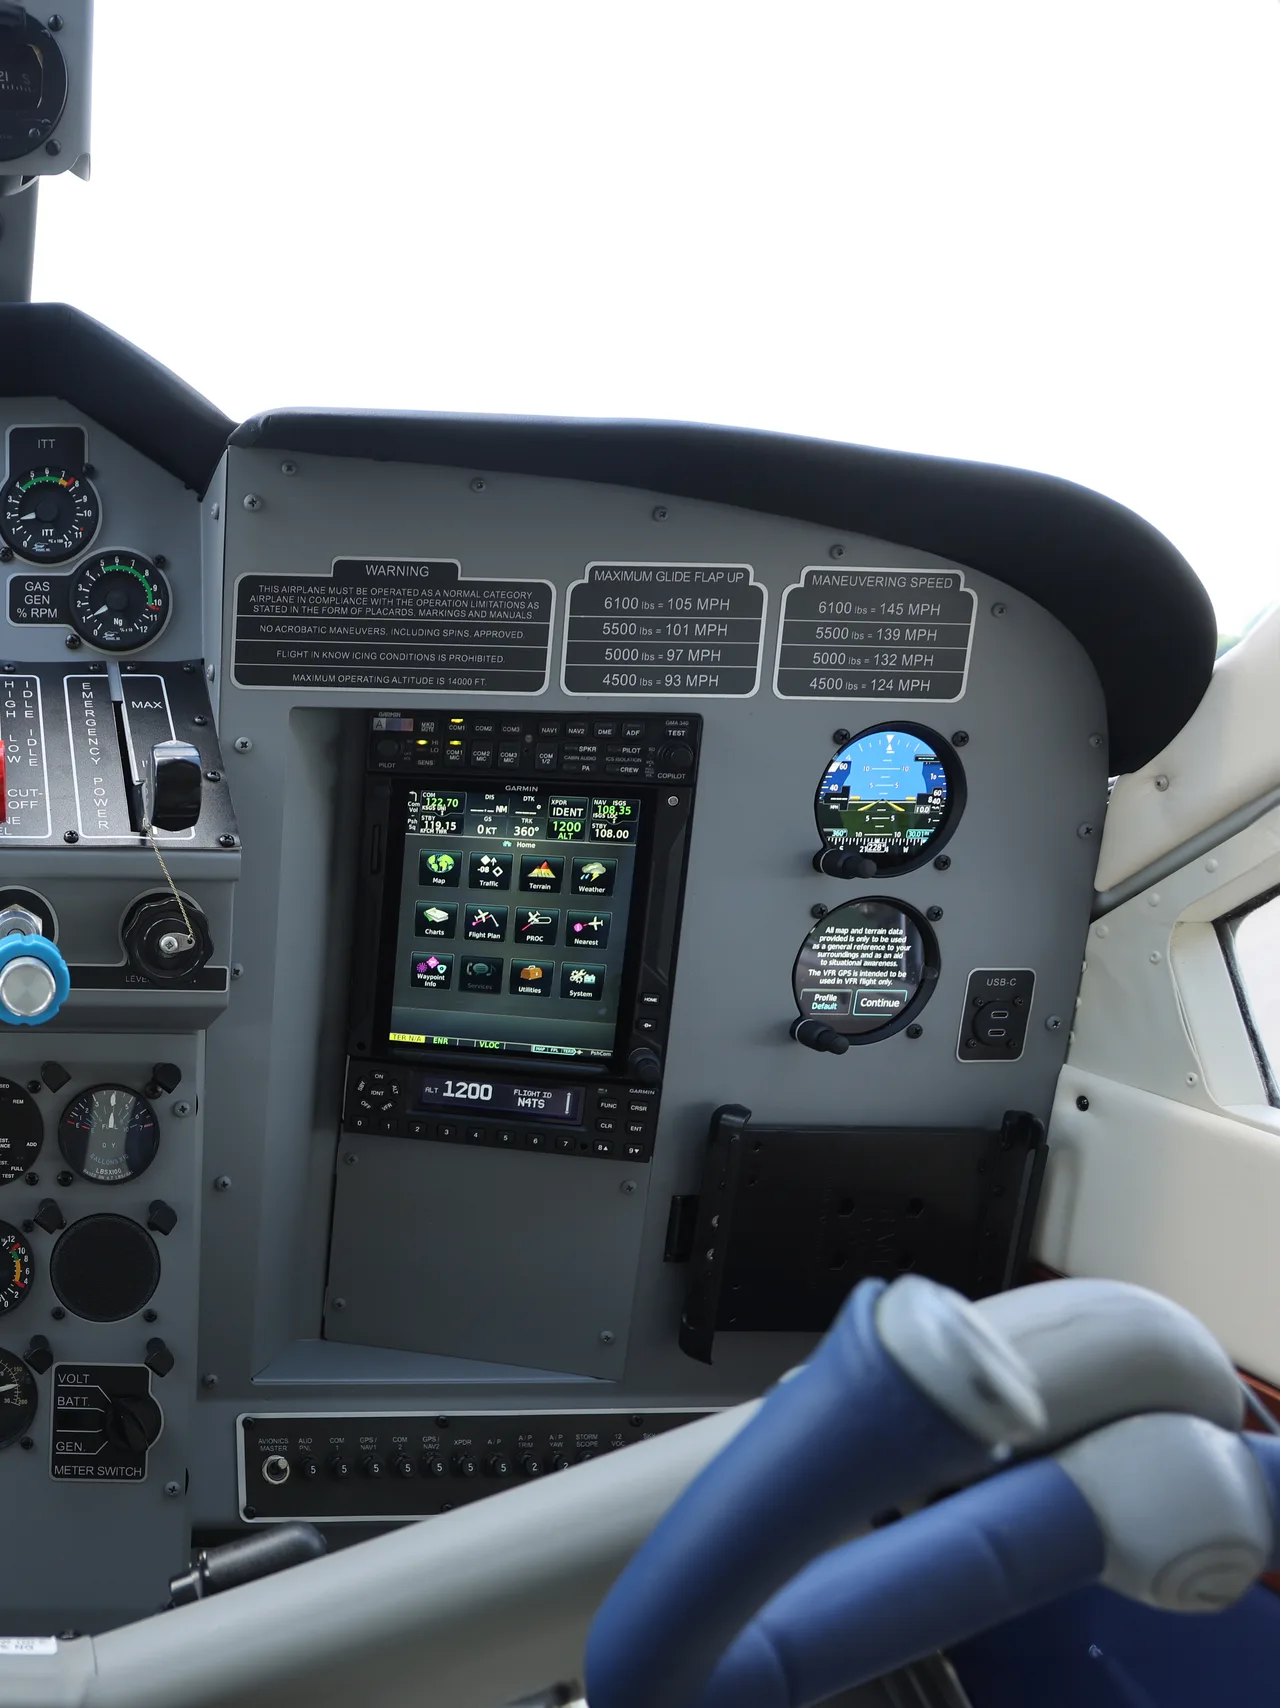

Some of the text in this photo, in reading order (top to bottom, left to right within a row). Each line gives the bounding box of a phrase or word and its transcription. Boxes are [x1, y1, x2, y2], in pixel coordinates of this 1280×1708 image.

[37, 439, 56, 448] ITT
[365, 565, 429, 577] WARNING
[594, 571, 744, 583] MAXIMUM GLIDE FLAP UP
[24, 581, 50, 591] GAS
[812, 576, 952, 589] MANEUVERING SPEED
[24, 595, 50, 604] GEN
[17, 608, 57, 618] % RPM
[818, 602, 852, 614] 6100
[854, 605, 868, 615] lbs
[880, 603, 904, 615] 145
[908, 604, 941, 616] MPH
[292, 674, 336, 682] MAXIMUM
[338, 675, 390, 684] OPERATING
[391, 676, 434, 684] ALTITUDE
[436, 677, 444, 685] IS
[448, 677, 472, 685] 14000
[82, 683, 109, 829] EMERGENCY POWER
[8, 789, 43, 797] CUT-
[8, 801, 38, 809] OFF
[425, 798, 458, 807] 122.70
[553, 808, 583, 817] IDENT
[552, 821, 581, 832] 1200
[595, 830, 629, 839] 108.00
[433, 877, 445, 885] Map
[425, 928, 444, 936] Charts
[574, 938, 599, 946] Nearest
[986, 978, 1016, 986] USB-C
[815, 993, 837, 1002] Profile
[812, 1002, 837, 1010] Default
[860, 998, 900, 1008] Continue
[443, 1080, 493, 1101] 1200
[514, 1089, 540, 1097] FLIGHT
[517, 1098, 545, 1108] N4TS
[58, 1374, 89, 1383] VOLT
[57, 1397, 90, 1406] BATT.
[56, 1442, 85, 1451] GEN.
[54, 1466, 142, 1477] METER SWITCH
